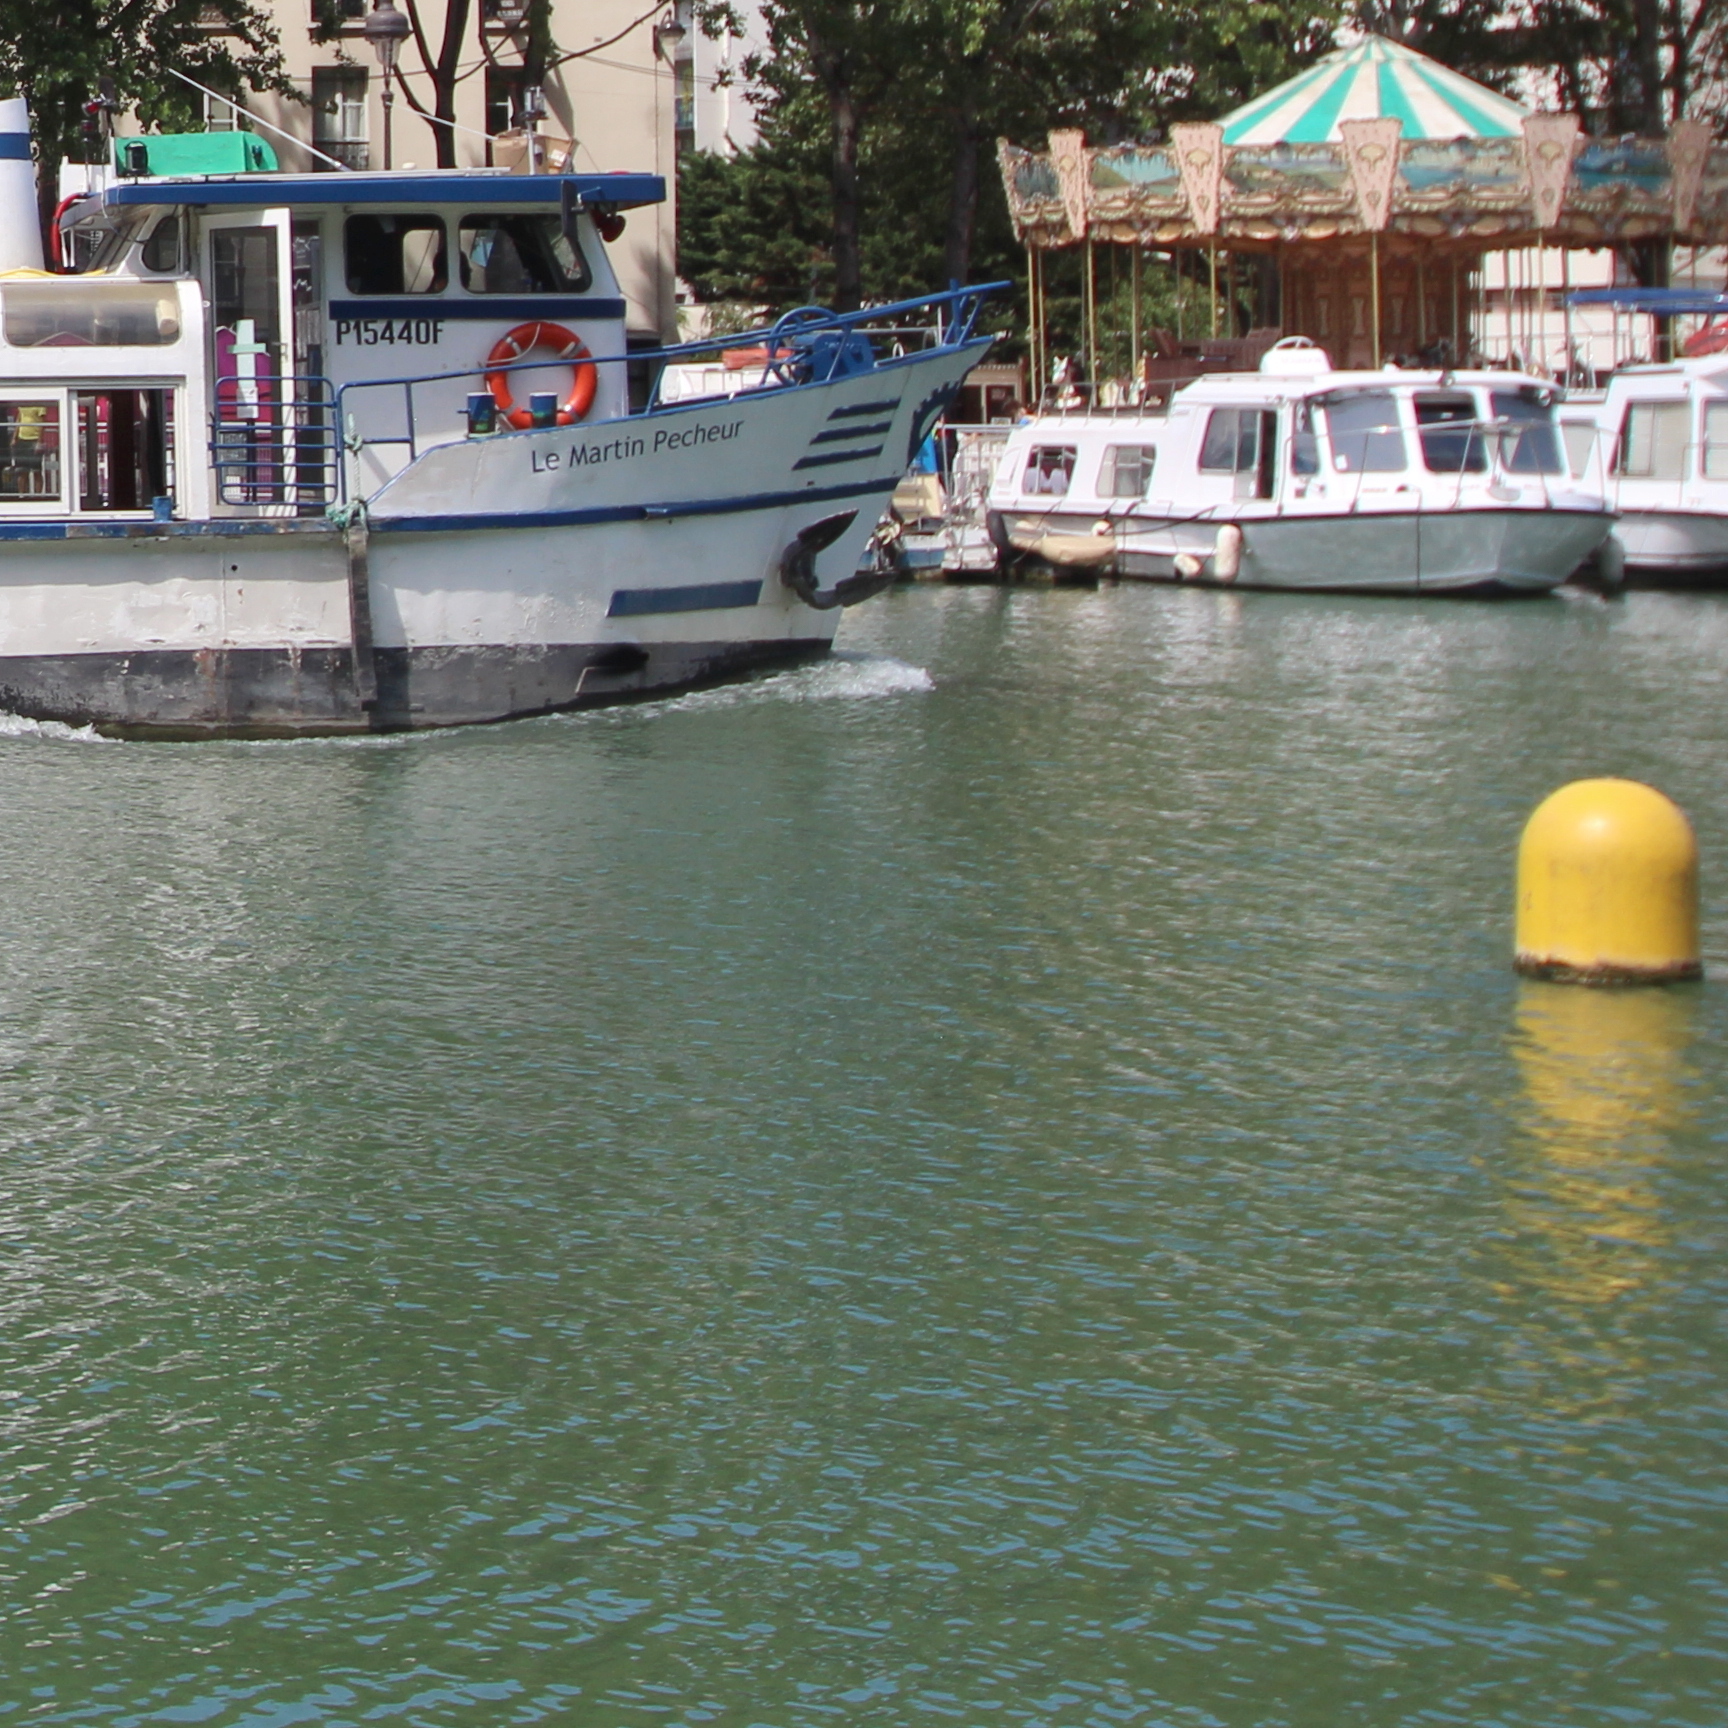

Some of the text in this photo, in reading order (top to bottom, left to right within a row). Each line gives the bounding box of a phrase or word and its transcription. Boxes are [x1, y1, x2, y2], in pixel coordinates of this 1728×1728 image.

[336, 319, 445, 346] P15440F
[531, 420, 746, 473] Le Martin Pecheur
